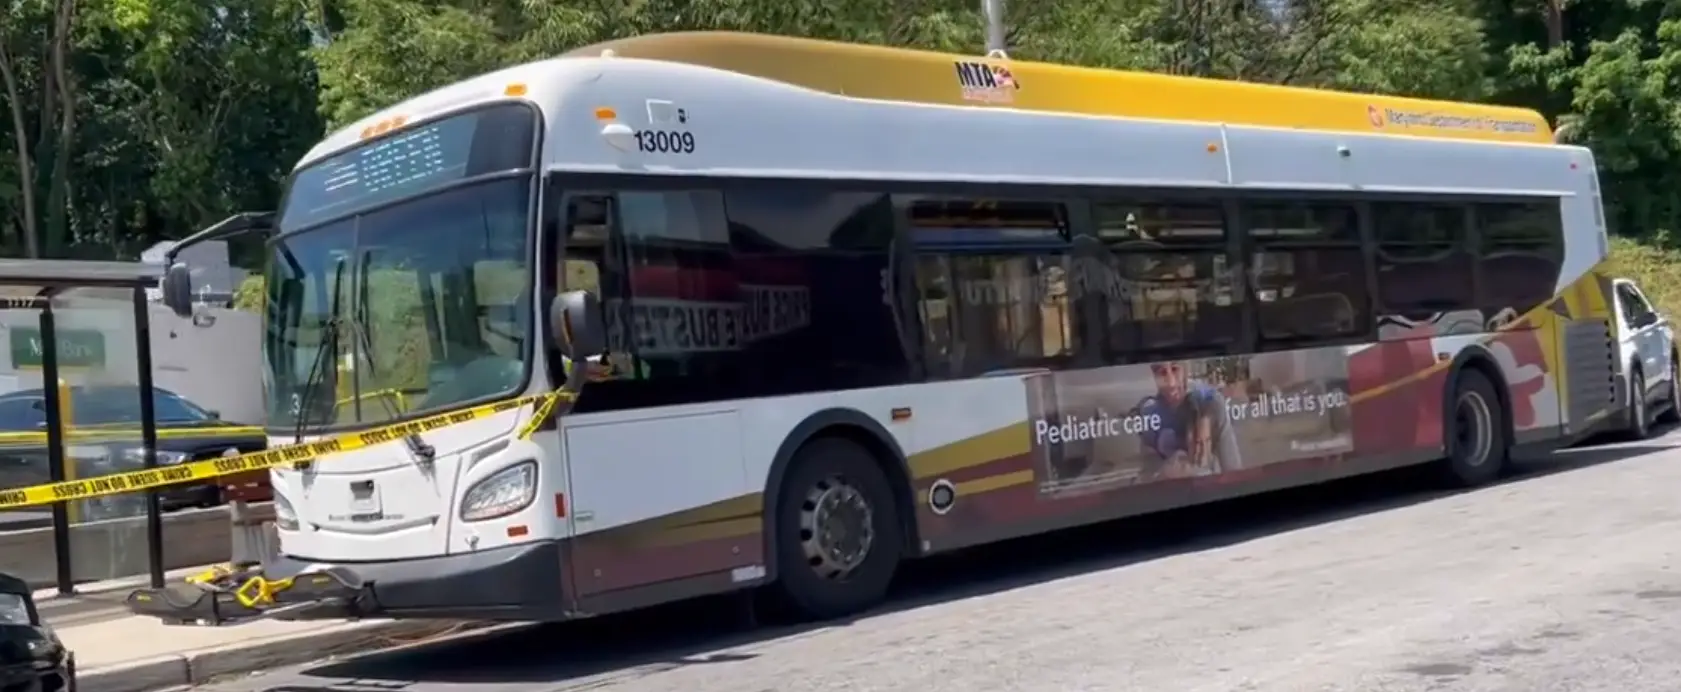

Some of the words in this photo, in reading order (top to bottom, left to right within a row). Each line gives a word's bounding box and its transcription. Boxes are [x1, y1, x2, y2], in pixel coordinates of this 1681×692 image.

[955, 61, 997, 88] MTA
[634, 130, 695, 153] 13009
[1036, 412, 1118, 445] Pediatric
[1123, 414, 1161, 434] care
[1224, 400, 1248, 421] for
[1251, 398, 1269, 418] all
[1271, 394, 1302, 415] that
[1304, 391, 1315, 411] is
[1317, 393, 1347, 416] you.
[52, 482, 88, 499] CROSS
